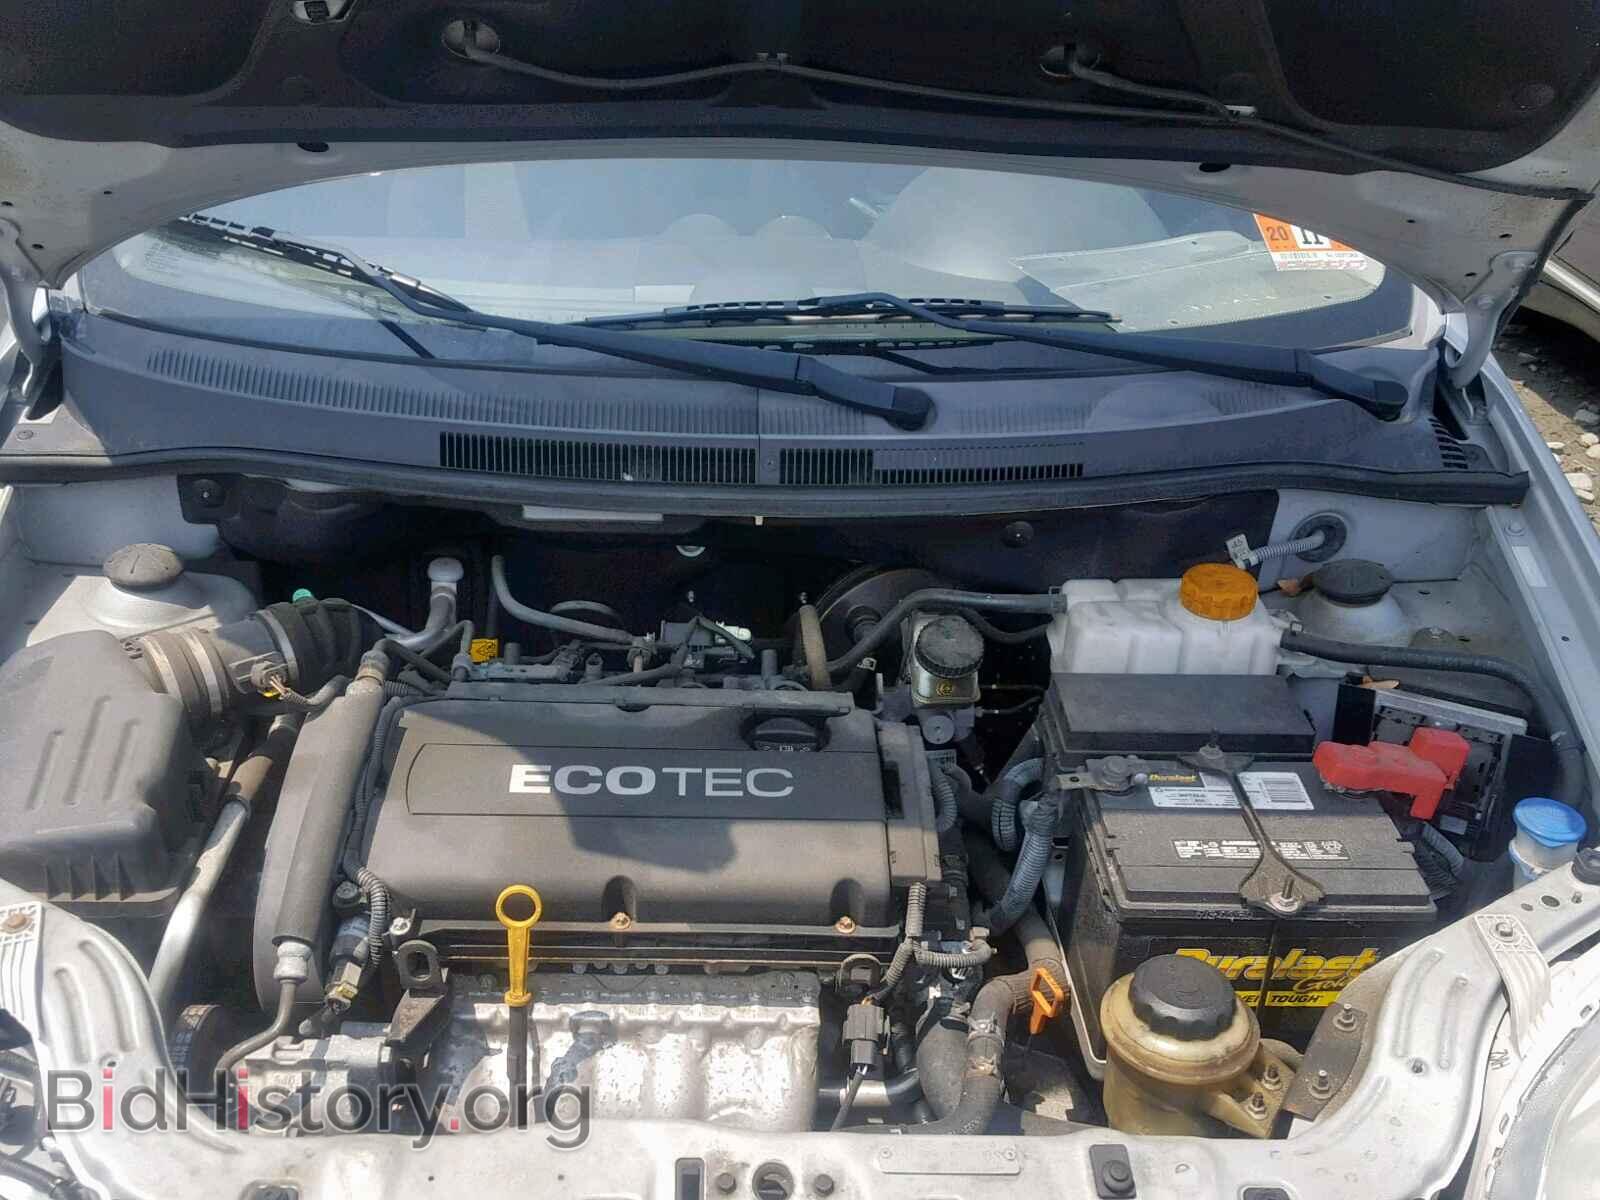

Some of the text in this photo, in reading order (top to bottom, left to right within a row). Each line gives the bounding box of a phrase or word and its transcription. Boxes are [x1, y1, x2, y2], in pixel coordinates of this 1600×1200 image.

[1266, 226, 1289, 241] 20
[508, 763, 795, 798] ECOTEC
[1271, 994, 1320, 1003] TOUGH
